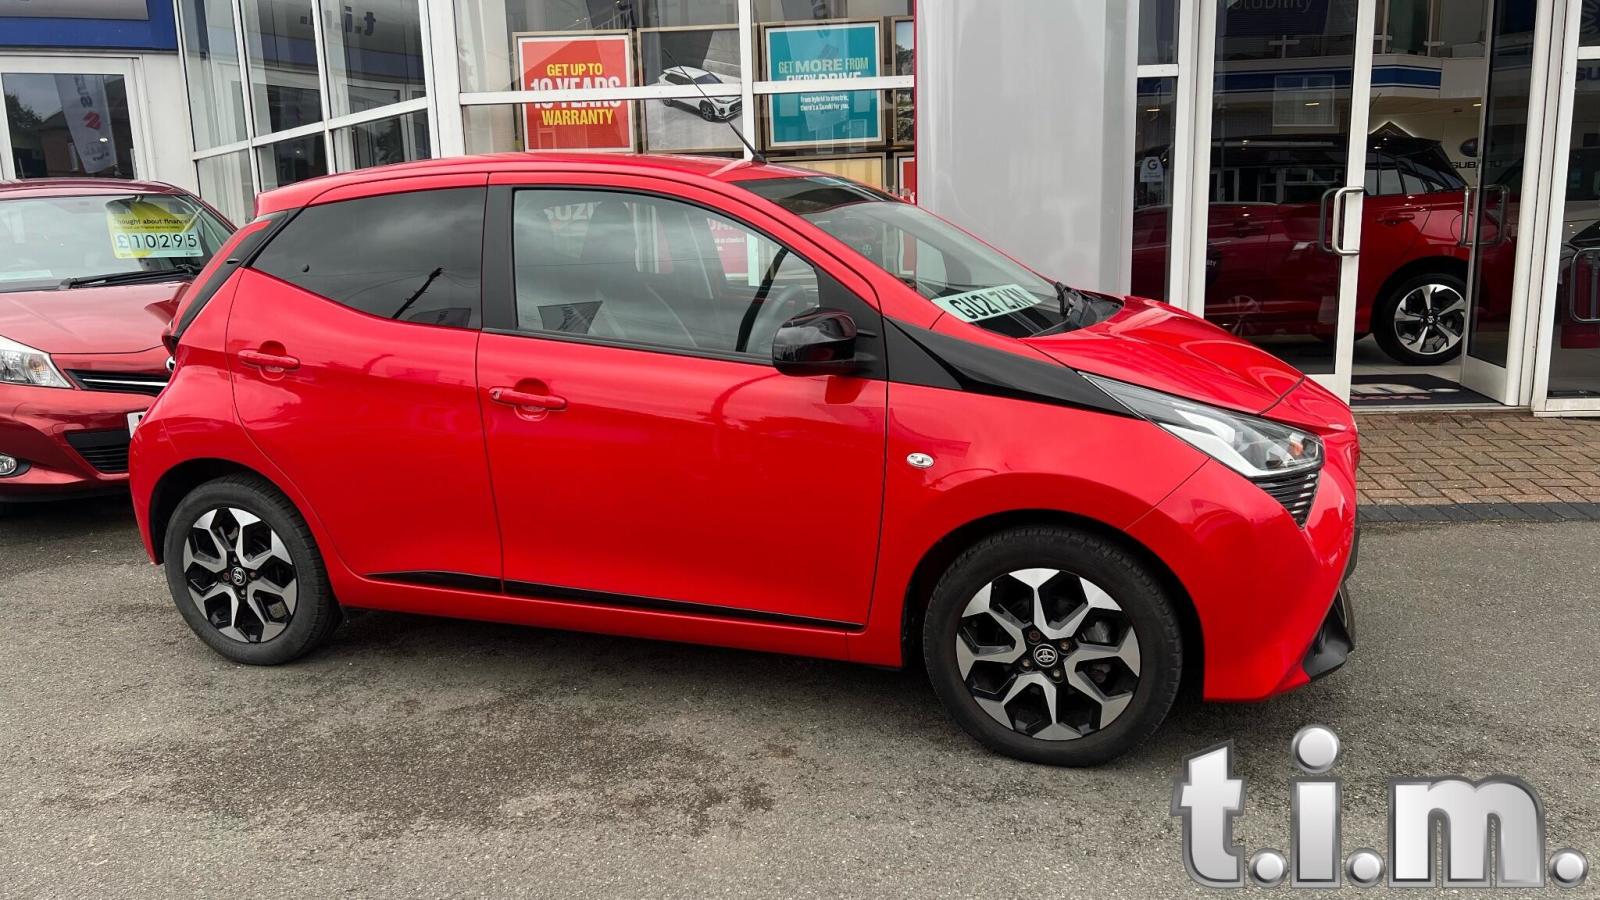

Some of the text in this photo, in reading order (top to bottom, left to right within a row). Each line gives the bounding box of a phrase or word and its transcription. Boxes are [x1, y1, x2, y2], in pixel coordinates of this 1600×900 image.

[546, 63, 603, 76] GET UP TO
[779, 57, 869, 74] GET MORE FROM
[557, 76, 621, 108] YEARS
[541, 109, 614, 126] WARRANTY
[117, 233, 198, 249] £10295
